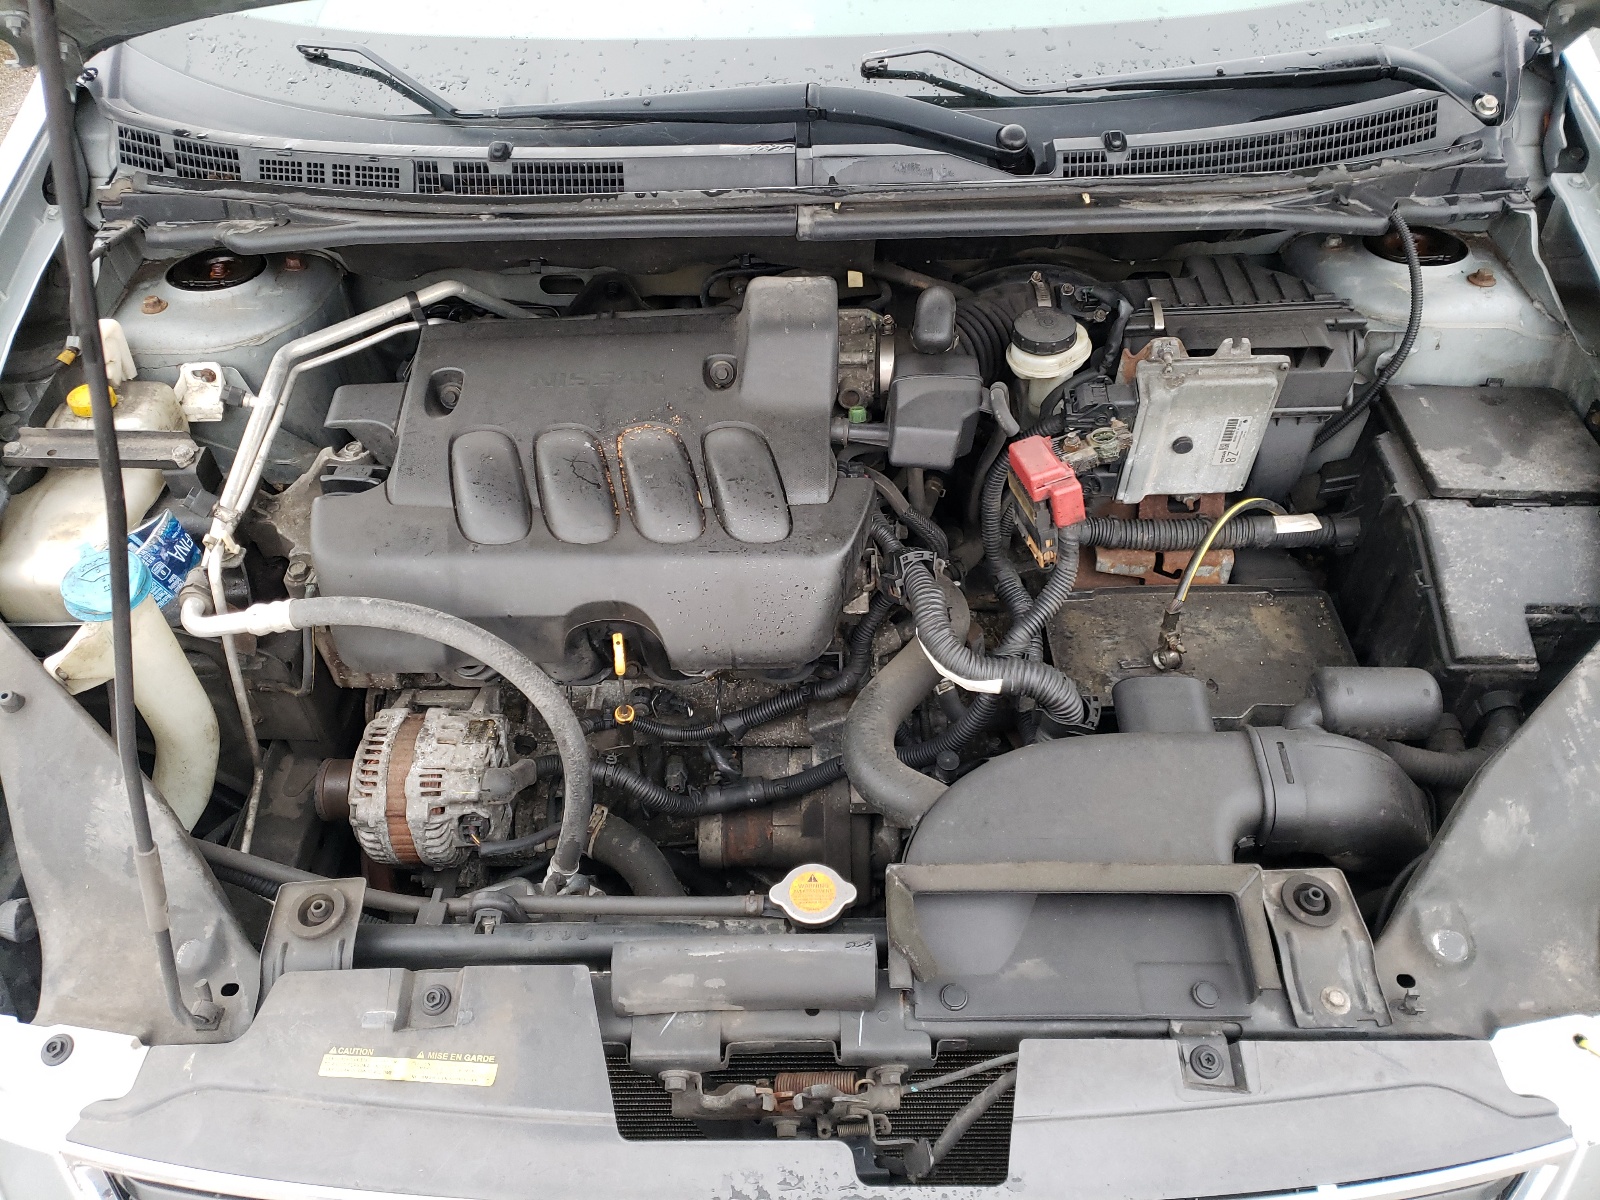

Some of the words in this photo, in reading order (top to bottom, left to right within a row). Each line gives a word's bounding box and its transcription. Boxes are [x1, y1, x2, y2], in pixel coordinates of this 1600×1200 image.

[338, 1047, 374, 1056] CAUTION
[427, 1051, 449, 1060] MISE
[450, 1053, 463, 1061] EN
[463, 1053, 496, 1063] GARDE
